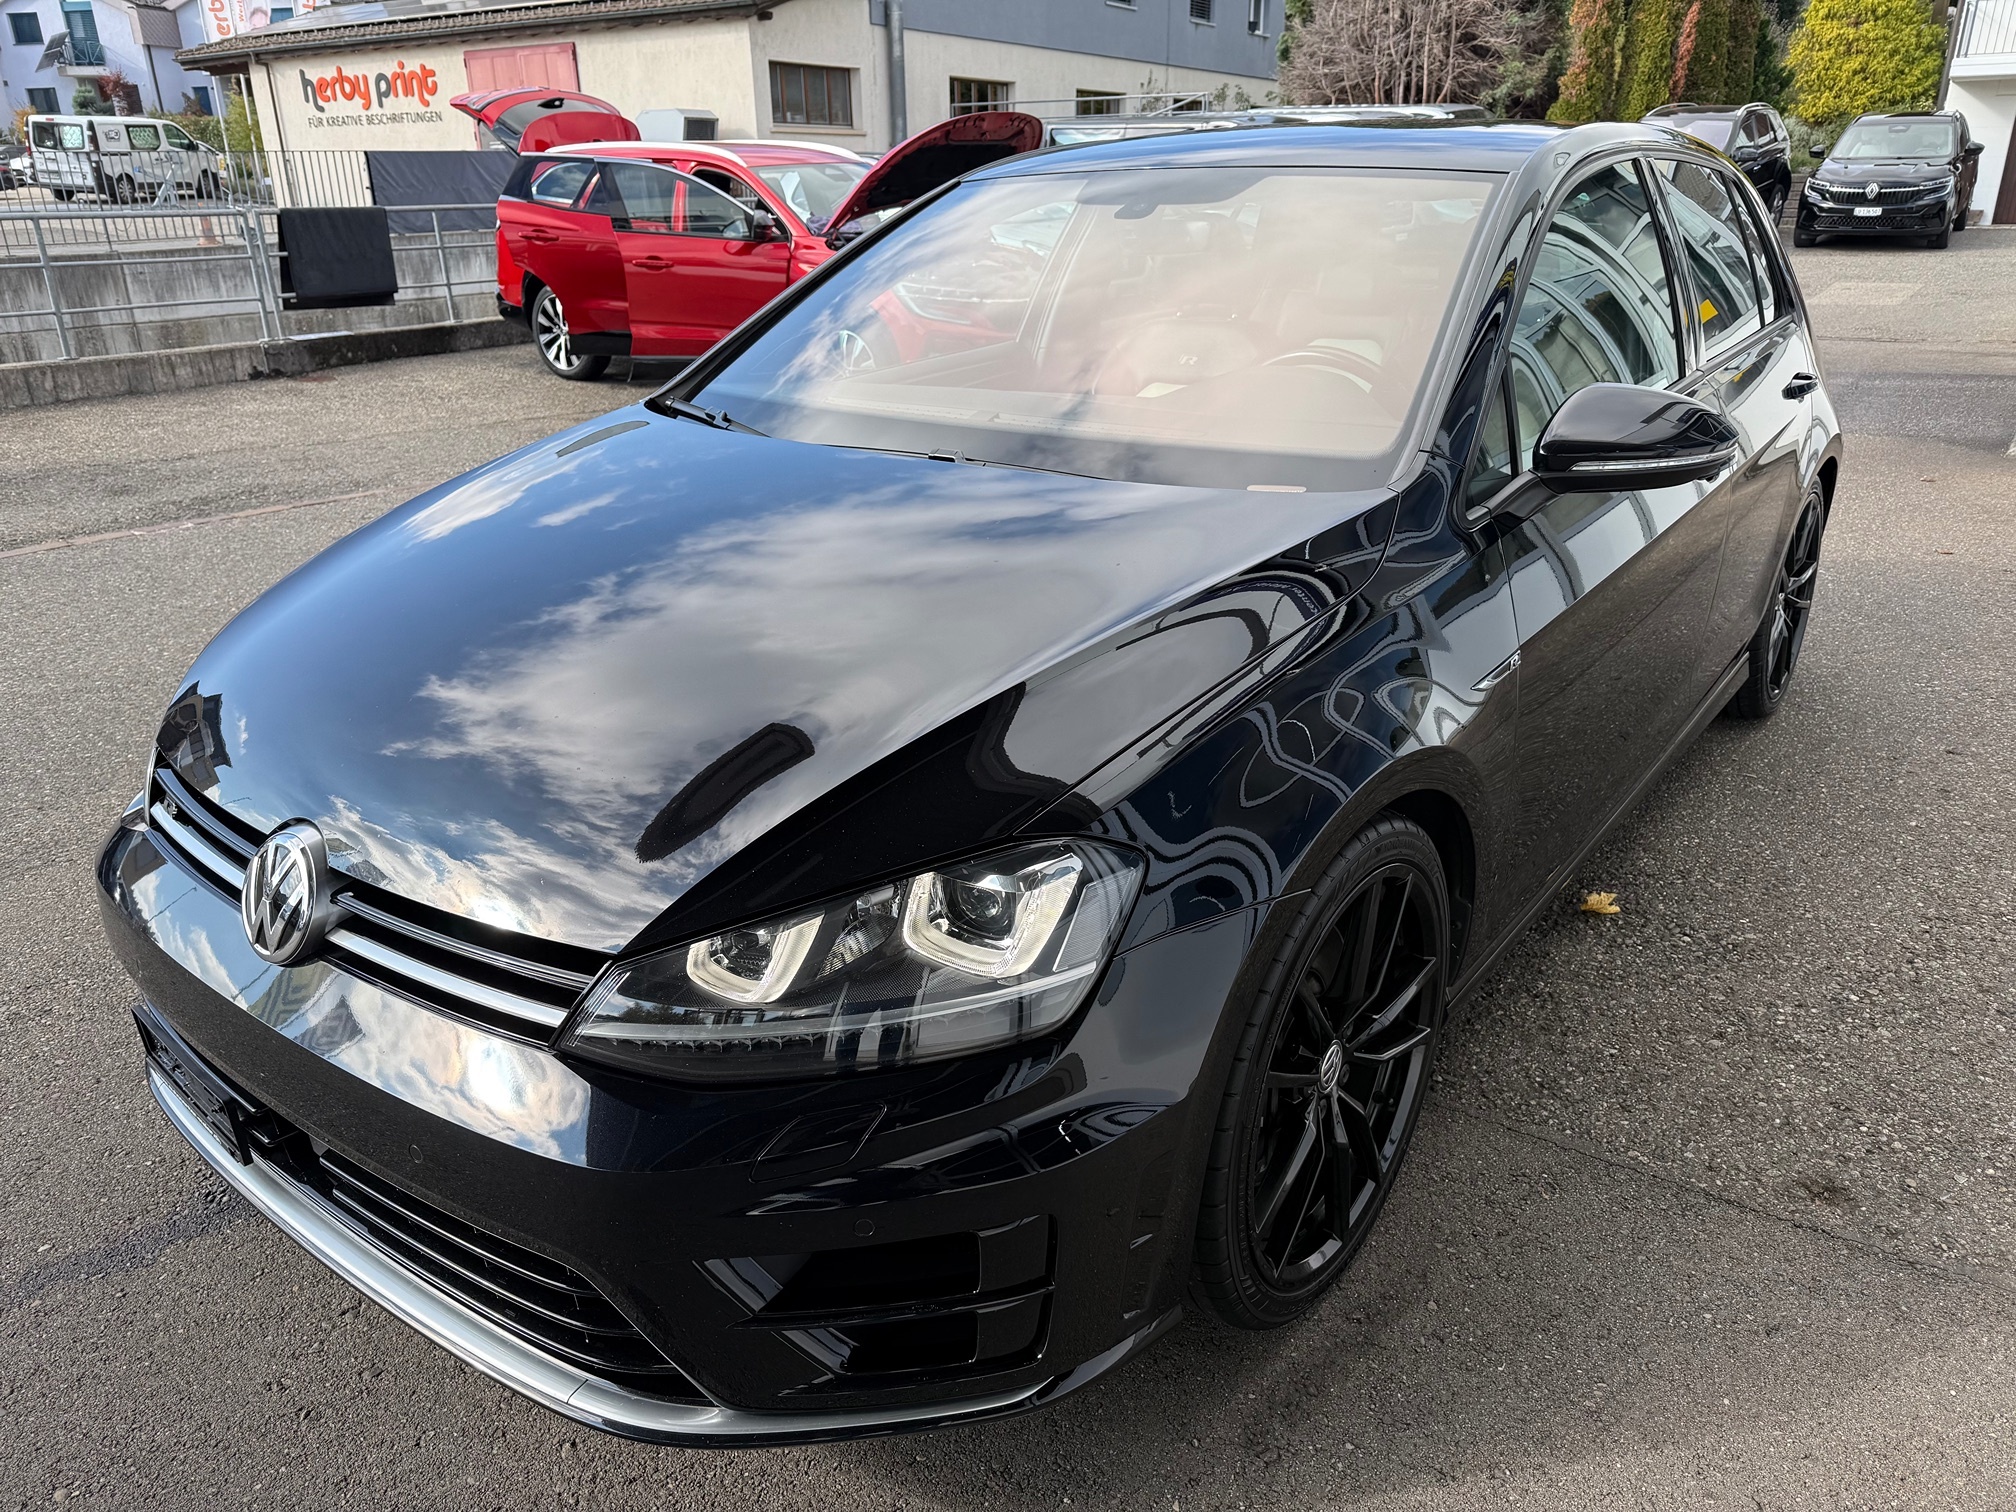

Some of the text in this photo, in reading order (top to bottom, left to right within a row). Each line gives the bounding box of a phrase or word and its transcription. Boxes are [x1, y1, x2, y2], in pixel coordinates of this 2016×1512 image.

[299, 60, 438, 113] herby print
[308, 111, 443, 128] FÜR KREATIVE BESCHRIFTUNGEN
